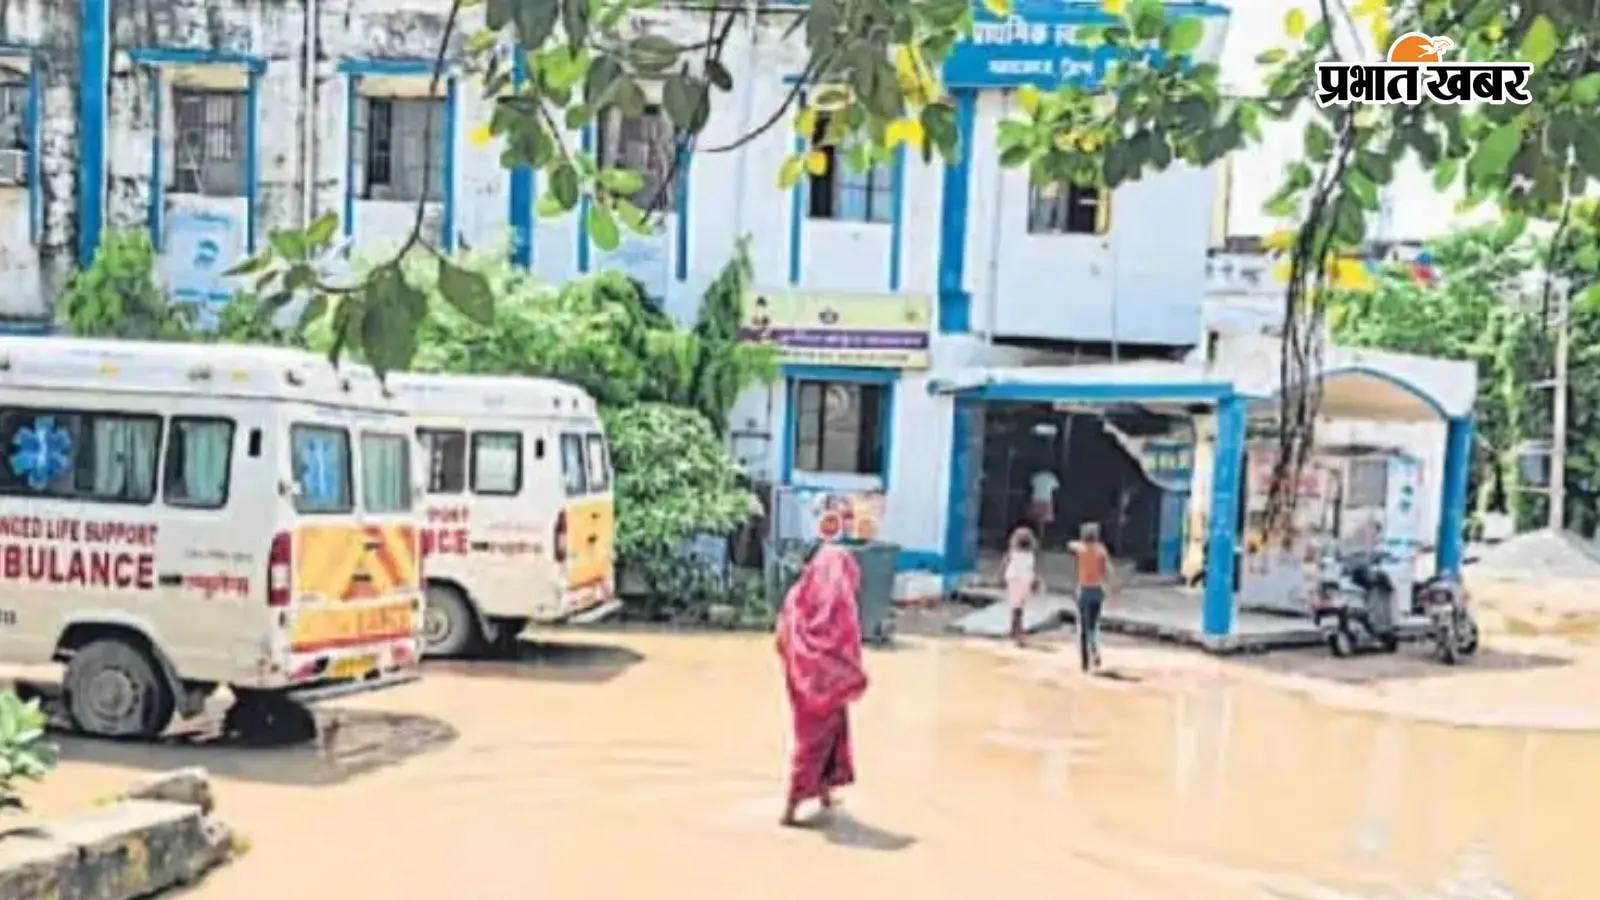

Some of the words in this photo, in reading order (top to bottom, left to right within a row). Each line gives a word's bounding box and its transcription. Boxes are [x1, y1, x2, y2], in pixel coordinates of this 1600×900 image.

[47, 518, 80, 541] LIFE
[84, 521, 159, 545] SUPPORT
[0, 543, 154, 590] BULANCE
